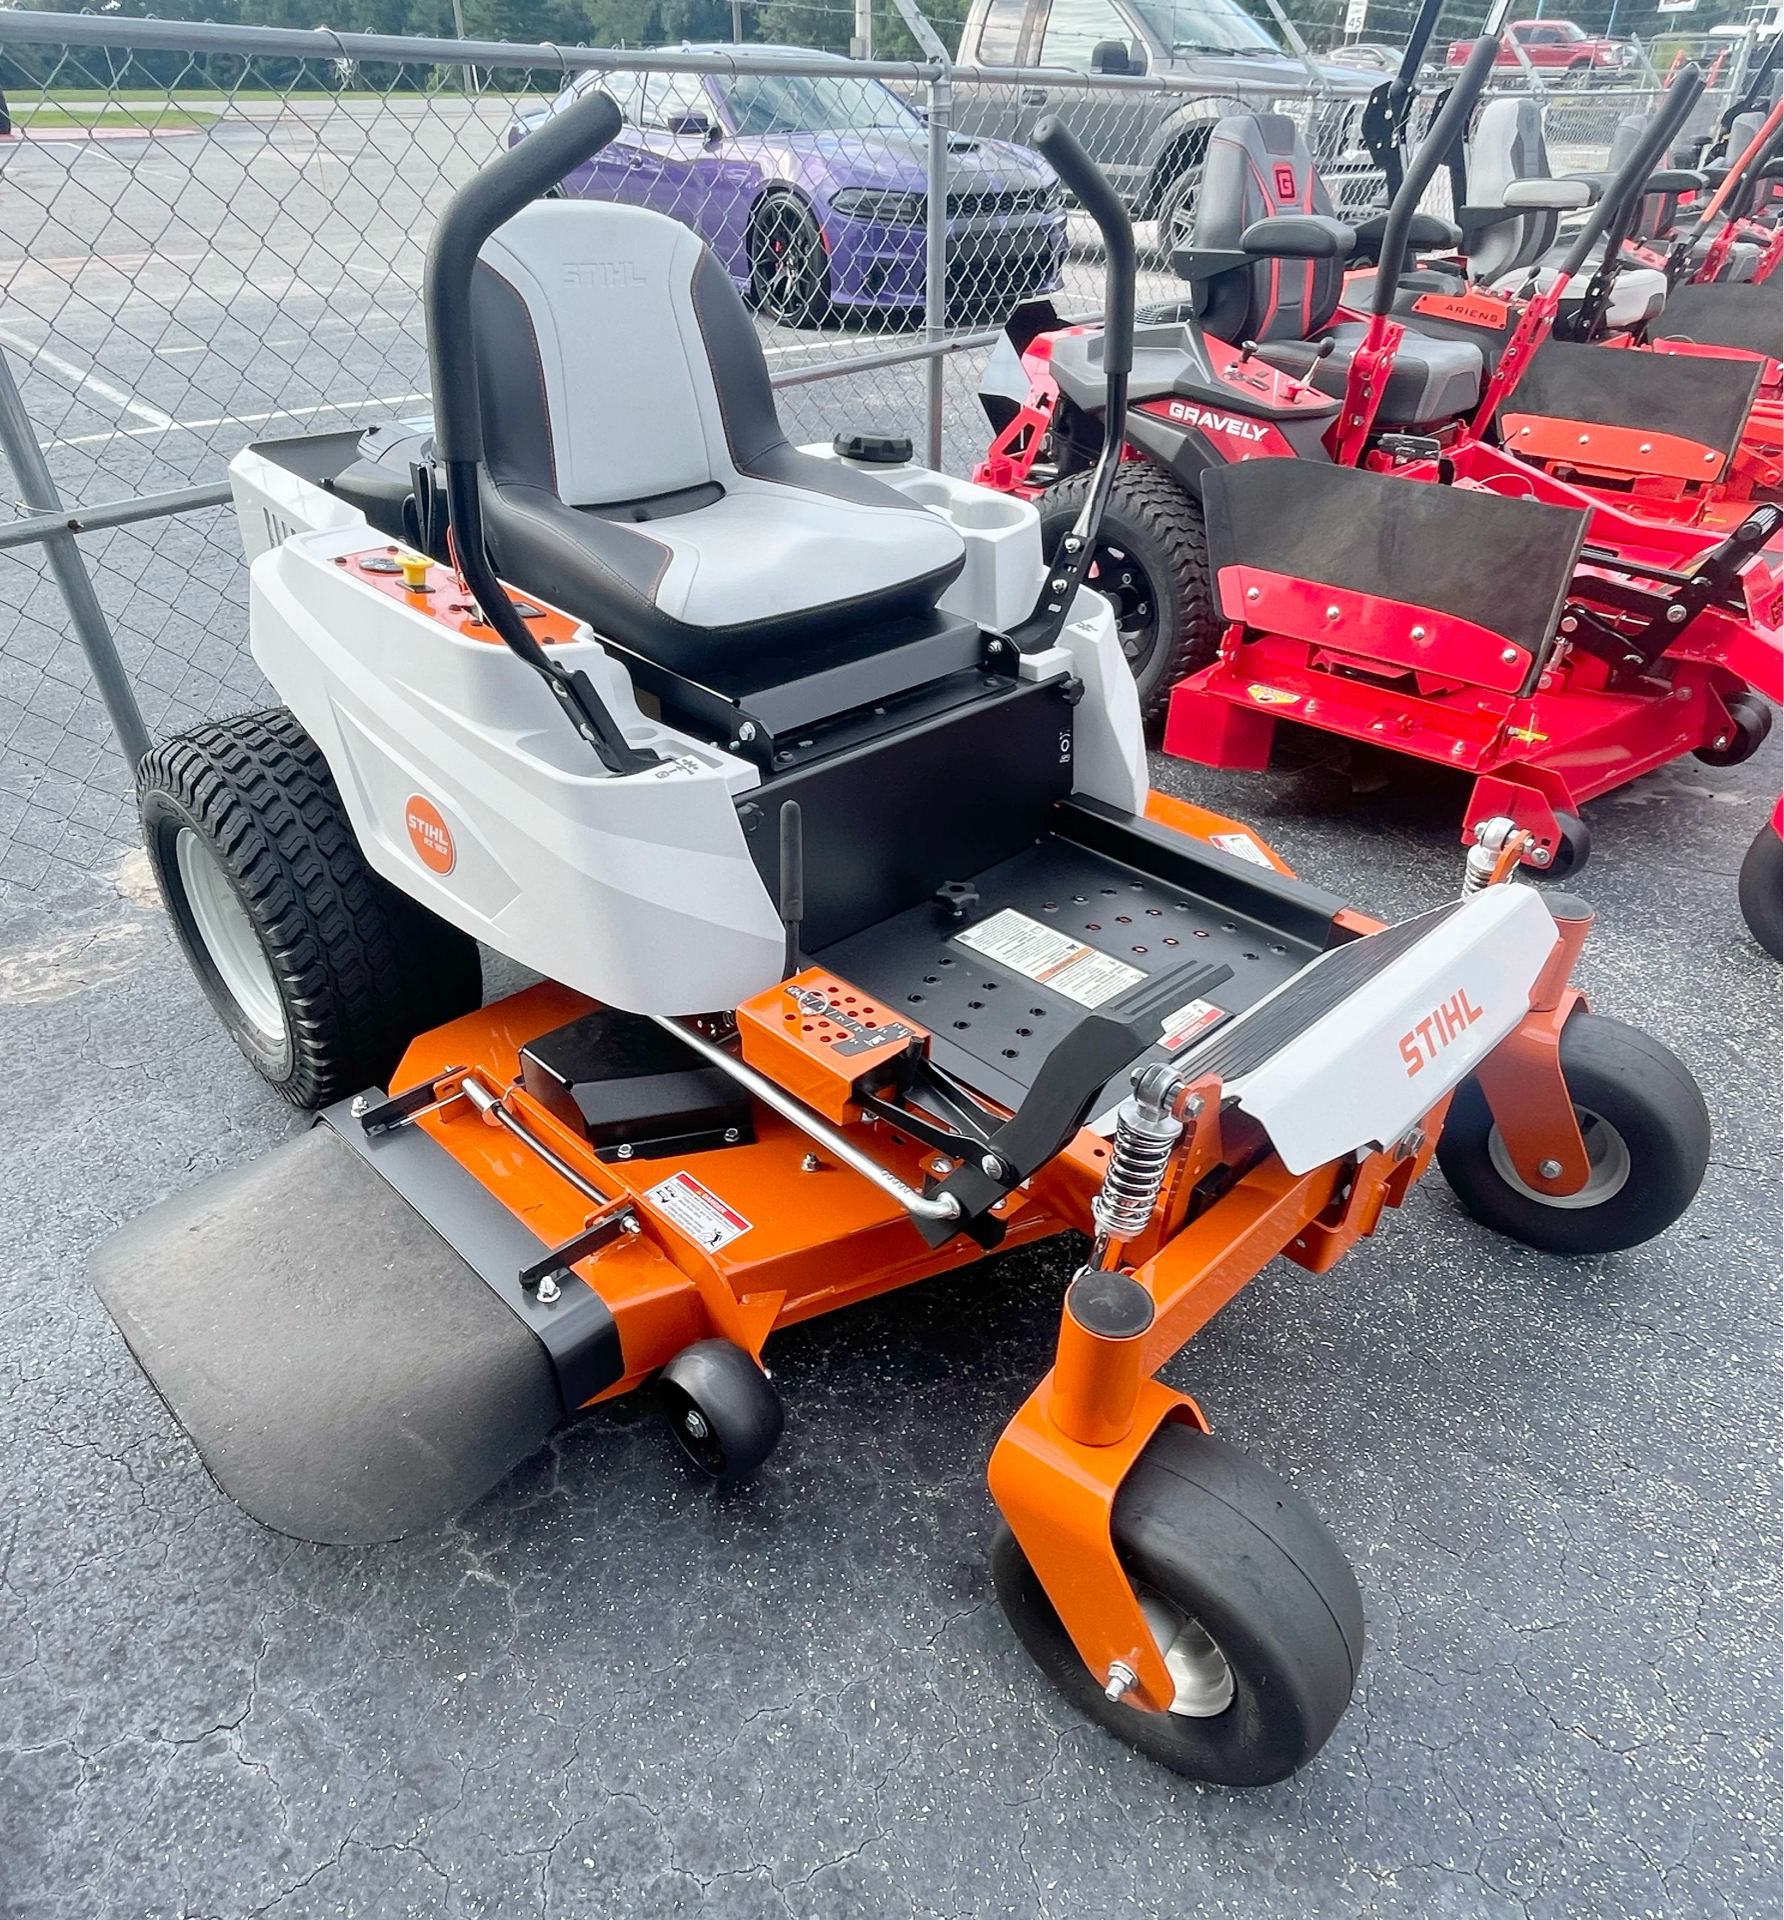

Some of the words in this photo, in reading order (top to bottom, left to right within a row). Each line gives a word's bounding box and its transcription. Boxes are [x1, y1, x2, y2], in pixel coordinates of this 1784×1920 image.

[1348, 16, 1362, 29] 45
[562, 261, 647, 289] STIHL
[1445, 304, 1498, 323] ARIENS
[1168, 402, 1270, 441] GRAVELY
[408, 813, 448, 847] STIHL
[1398, 988, 1484, 1079] STIHL
[701, 1192, 728, 1214] DANGER
